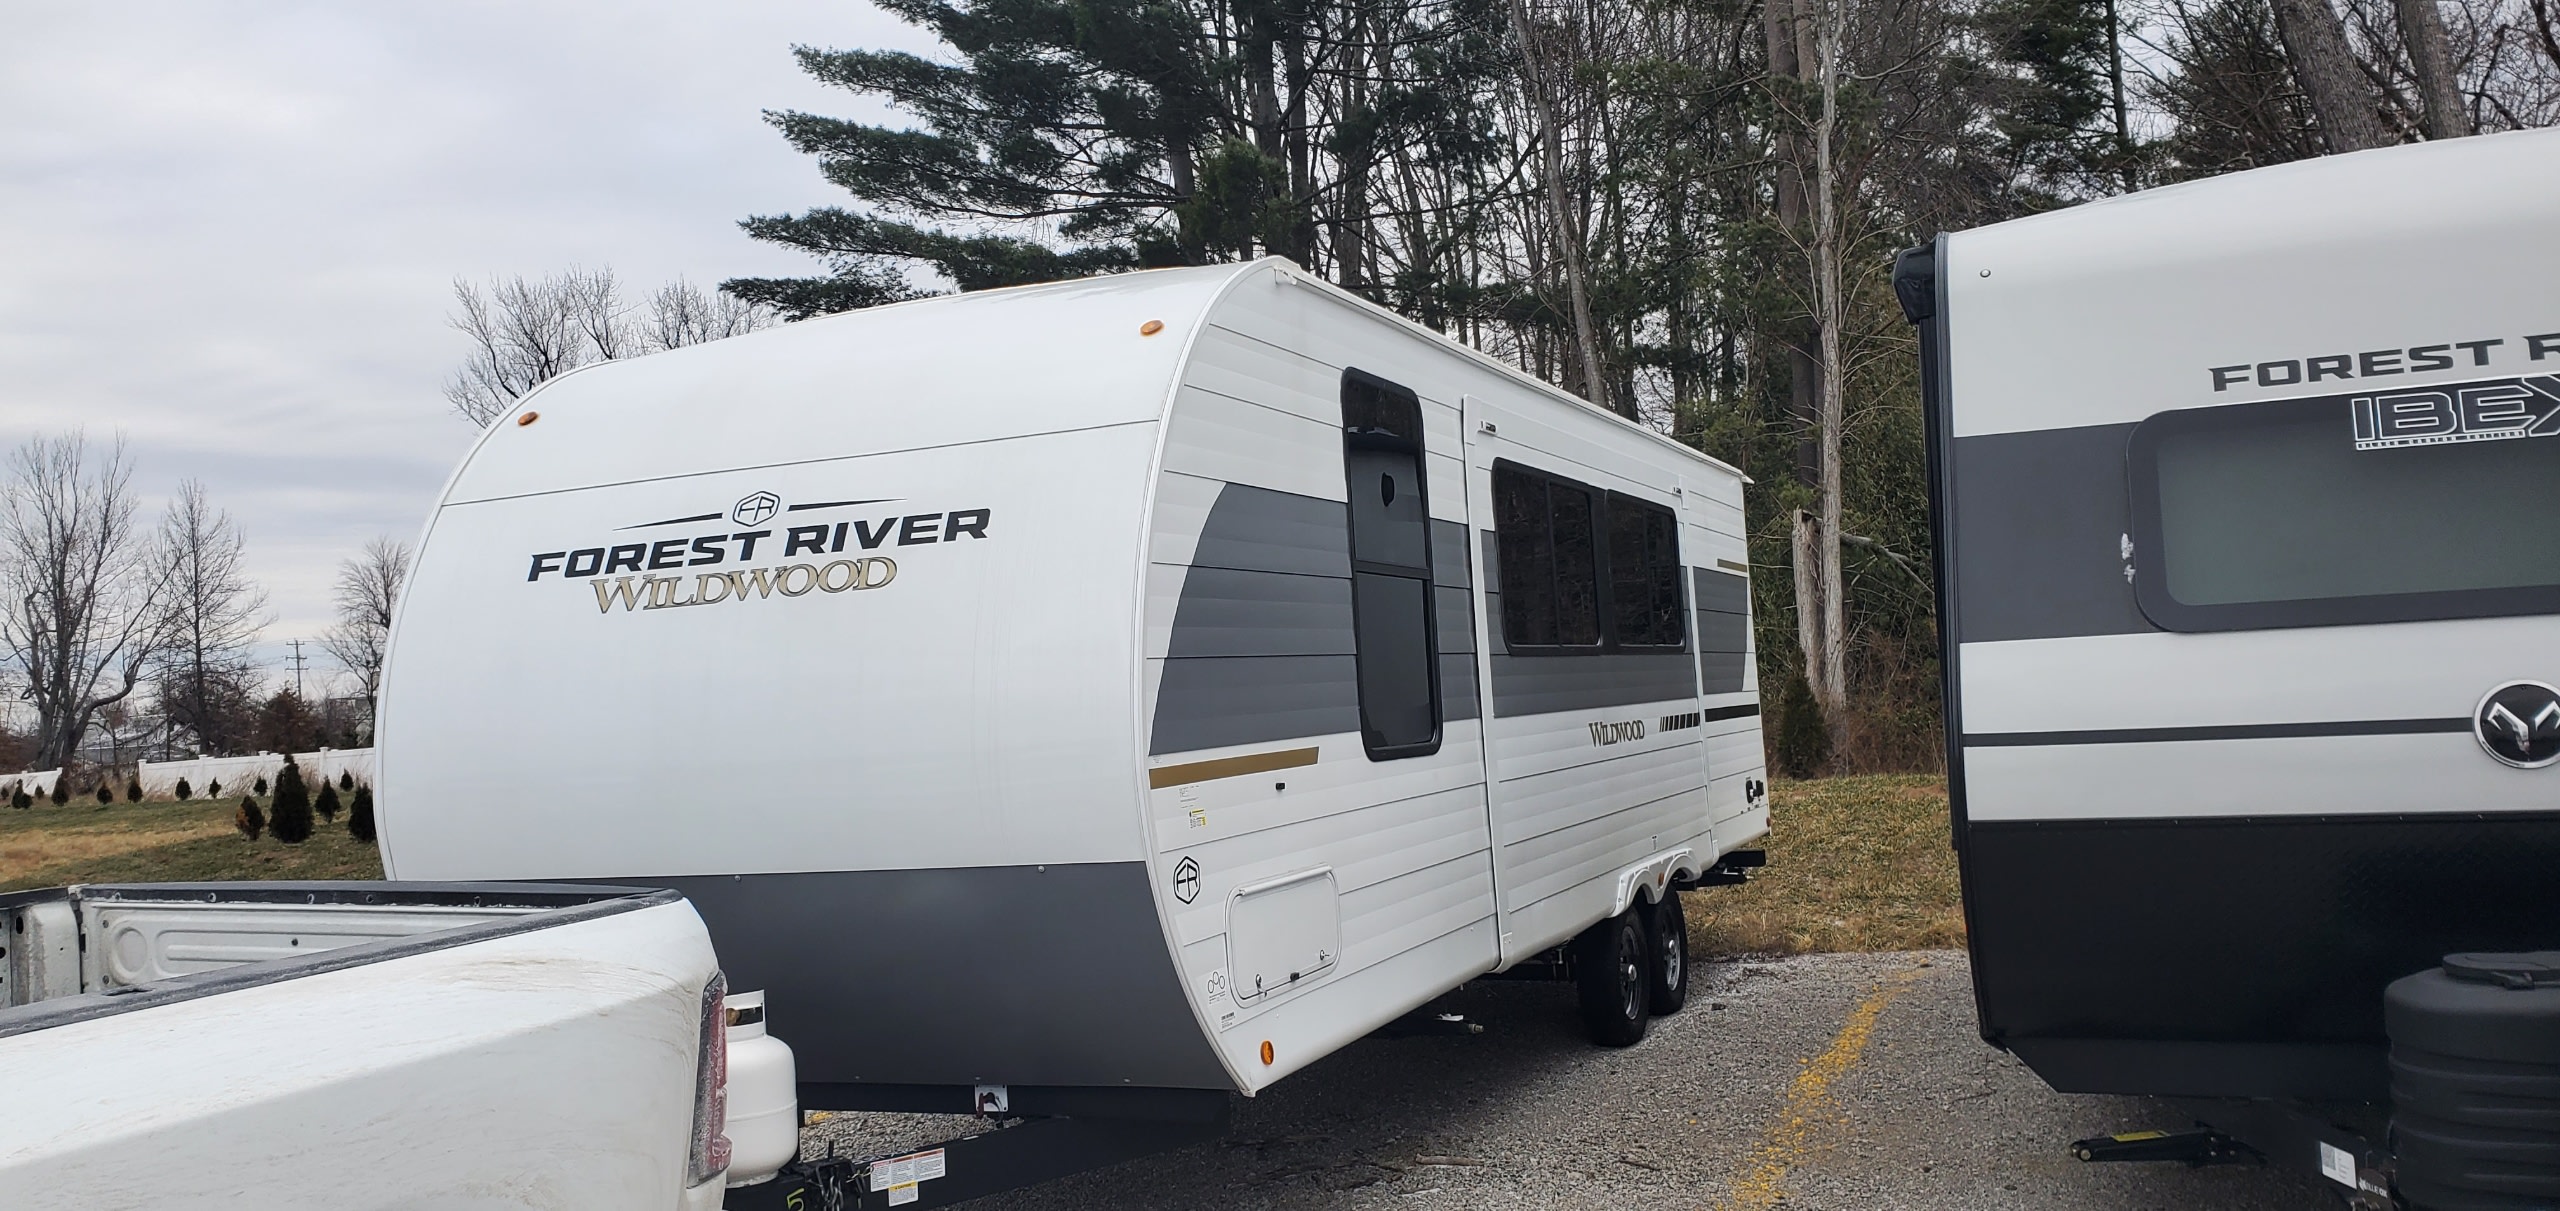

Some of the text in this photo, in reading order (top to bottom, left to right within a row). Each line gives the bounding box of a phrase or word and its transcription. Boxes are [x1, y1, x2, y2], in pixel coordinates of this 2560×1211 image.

[2208, 338, 2504, 392] FOREST
[527, 508, 991, 582] FOREST RIVER
[589, 556, 897, 614] WILDWOOD
[1588, 719, 1645, 747] WILDWOOD
